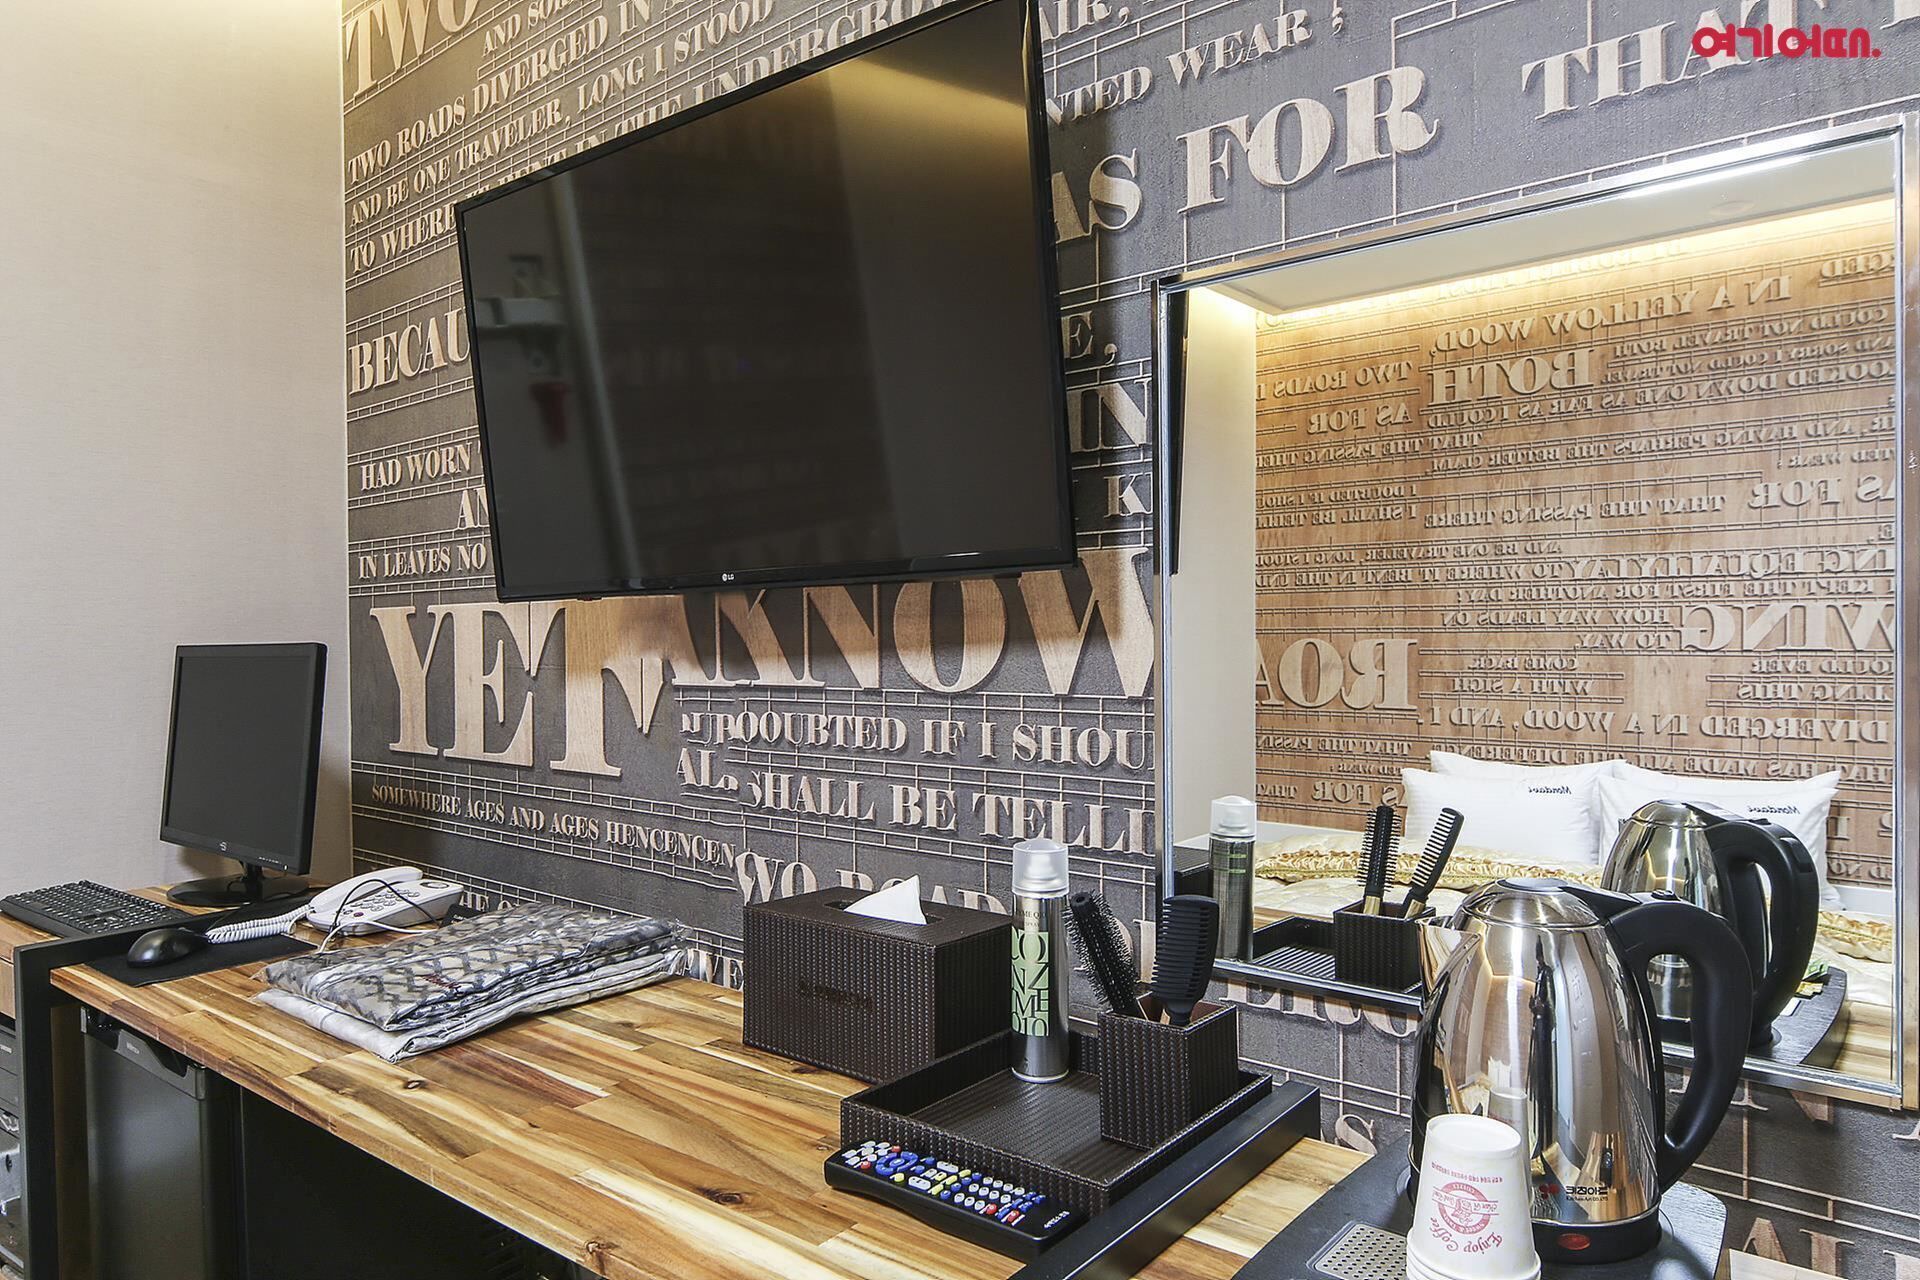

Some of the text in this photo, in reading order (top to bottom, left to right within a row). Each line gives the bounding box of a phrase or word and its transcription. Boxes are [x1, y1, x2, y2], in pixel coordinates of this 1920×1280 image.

[483, 13, 521, 57] AND
[1165, 9, 1313, 85] WEAR
[348, 0, 652, 185] TWO ROADS DIVERGED IN
[349, 193, 381, 227] AND
[386, 178, 410, 210] BE
[413, 156, 451, 194] ONE
[454, 98, 572, 174] TRAVELER,
[577, 55, 646, 114] LONG
[653, 43, 668, 77] I
[673, 0, 776, 66] STOOD
[1176, 66, 1440, 214] FOR
[350, 239, 376, 274] TO
[381, 200, 457, 259] WHERE
[360, 442, 472, 492] HAD WORN
[358, 543, 487, 579] IN LEAVES NO
[920, 719, 998, 760] IF I
[371, 784, 462, 816] SOMEWHERE
[464, 799, 505, 825] AGES
[508, 806, 545, 832] AND
[549, 813, 599, 841] AGES
[888, 784, 957, 832] BE
